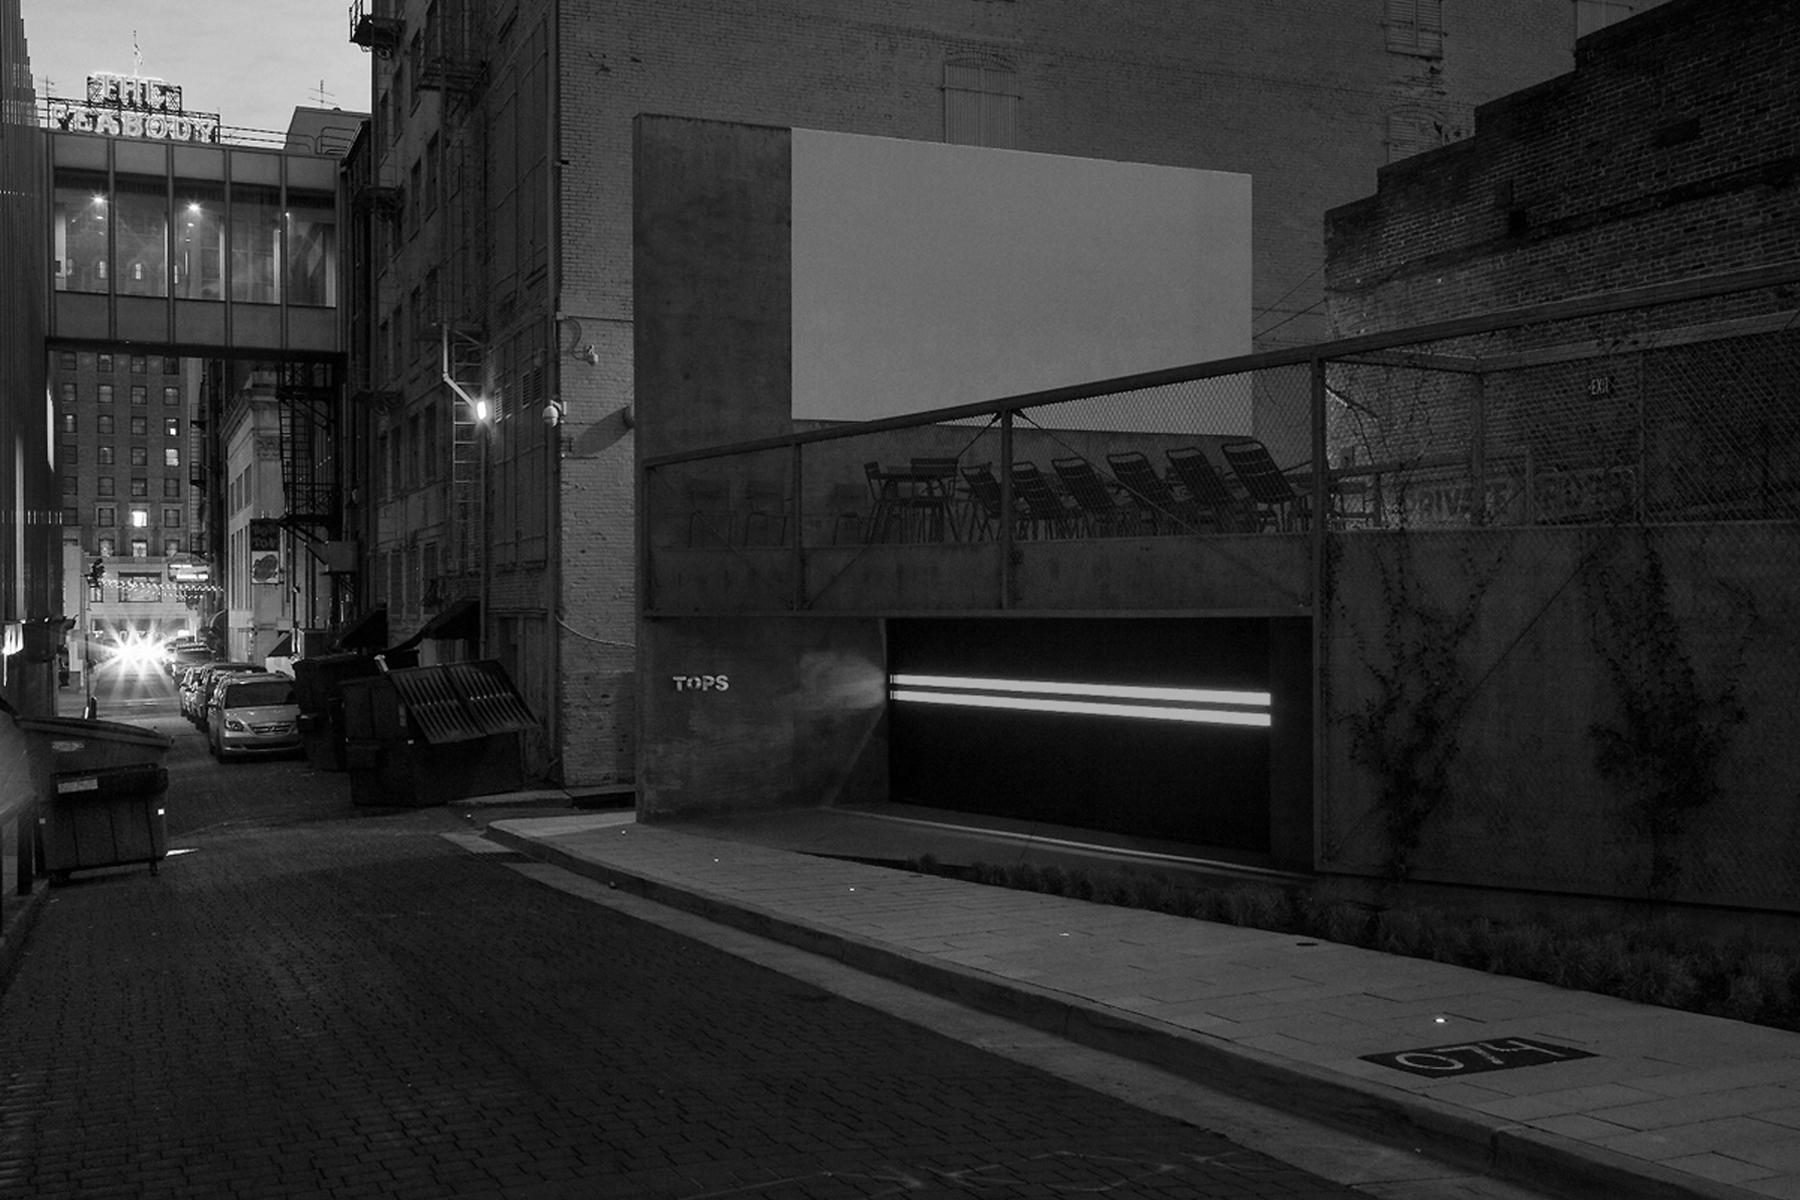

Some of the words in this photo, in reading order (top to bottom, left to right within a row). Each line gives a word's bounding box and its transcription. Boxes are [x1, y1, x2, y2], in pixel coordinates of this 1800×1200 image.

[96, 73, 165, 109] THE
[50, 105, 217, 143] PEABODY
[1591, 376, 1609, 395] EXIT
[672, 674, 730, 692] TOPS
